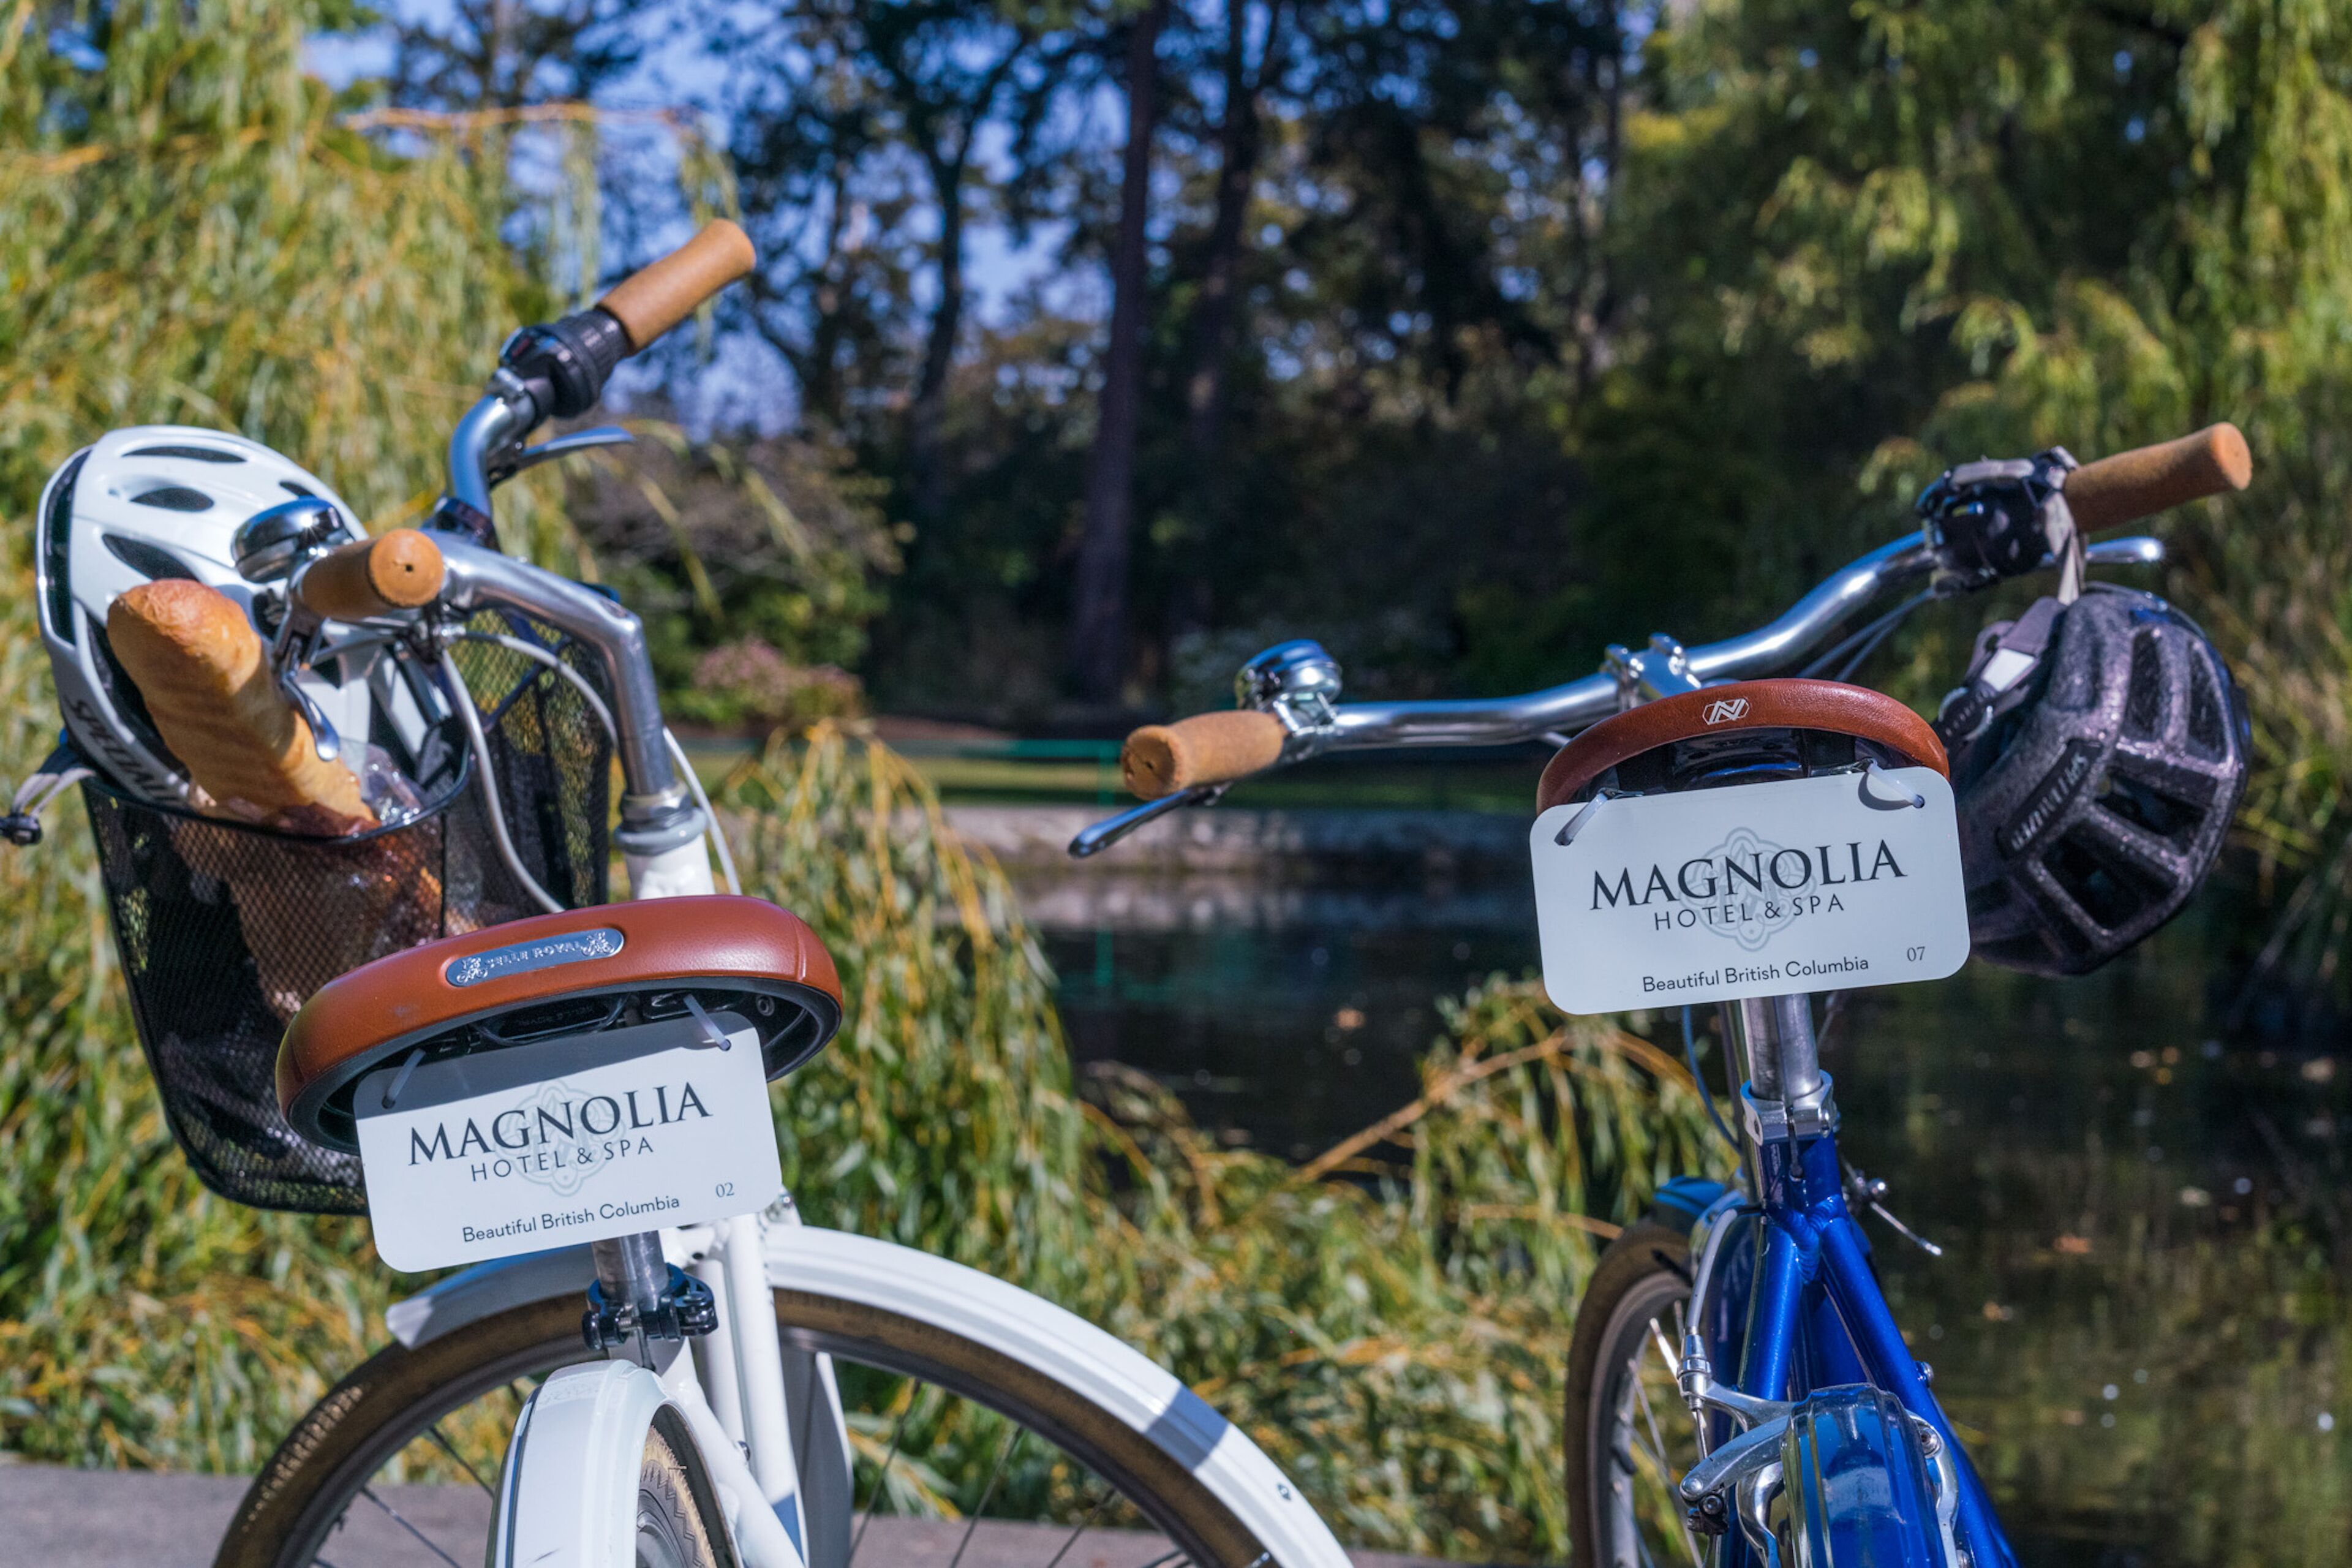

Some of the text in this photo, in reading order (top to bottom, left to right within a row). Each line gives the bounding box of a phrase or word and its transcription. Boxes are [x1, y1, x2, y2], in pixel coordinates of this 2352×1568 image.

[1590, 839, 1908, 910] MAGNOLIA
[1654, 894, 1845, 930] HOTEL & SPA
[1906, 946, 1926, 962] 07
[1643, 957, 1869, 993] Beautiful British Columbia
[409, 1082, 713, 1166] MAGNOLIA
[470, 1137, 654, 1182] HOTEL & SPA
[715, 1182, 734, 1199] 02
[462, 1196, 680, 1243] Beautiful British Columbia
